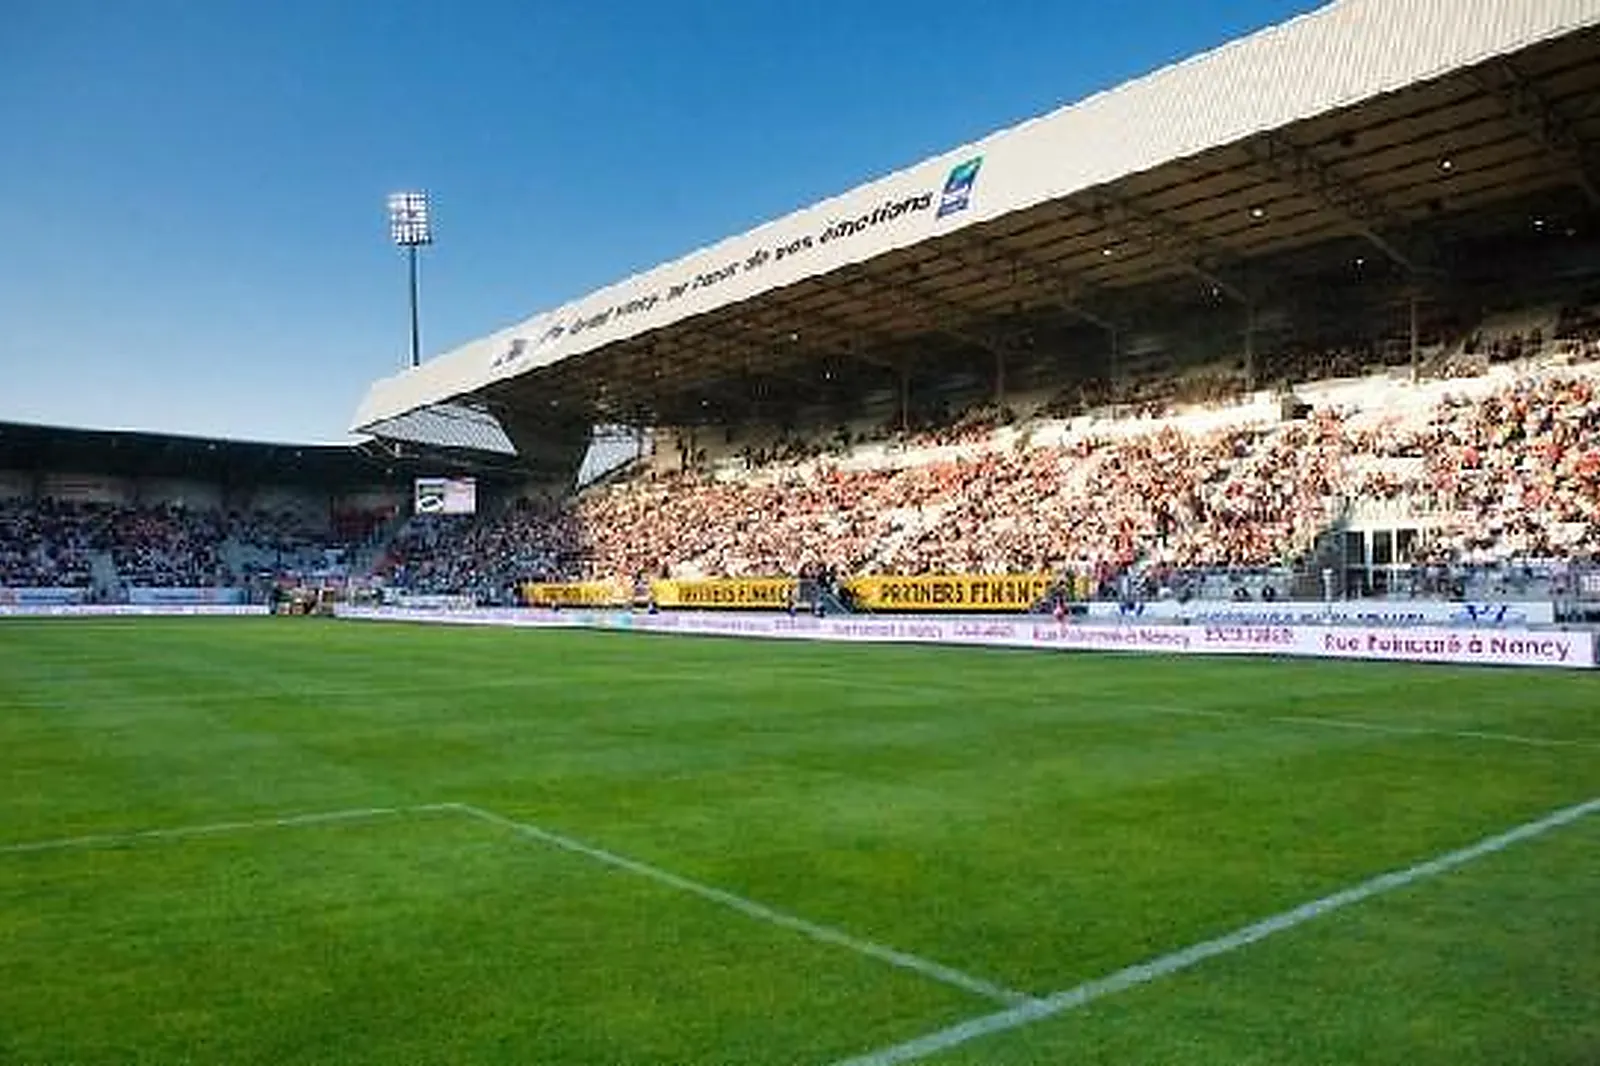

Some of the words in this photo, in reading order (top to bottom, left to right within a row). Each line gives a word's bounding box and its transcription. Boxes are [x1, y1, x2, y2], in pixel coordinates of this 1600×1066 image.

[1324, 633, 1359, 651] Rue
[1468, 634, 1483, 654] à
[1490, 640, 1571, 663] Nancy
